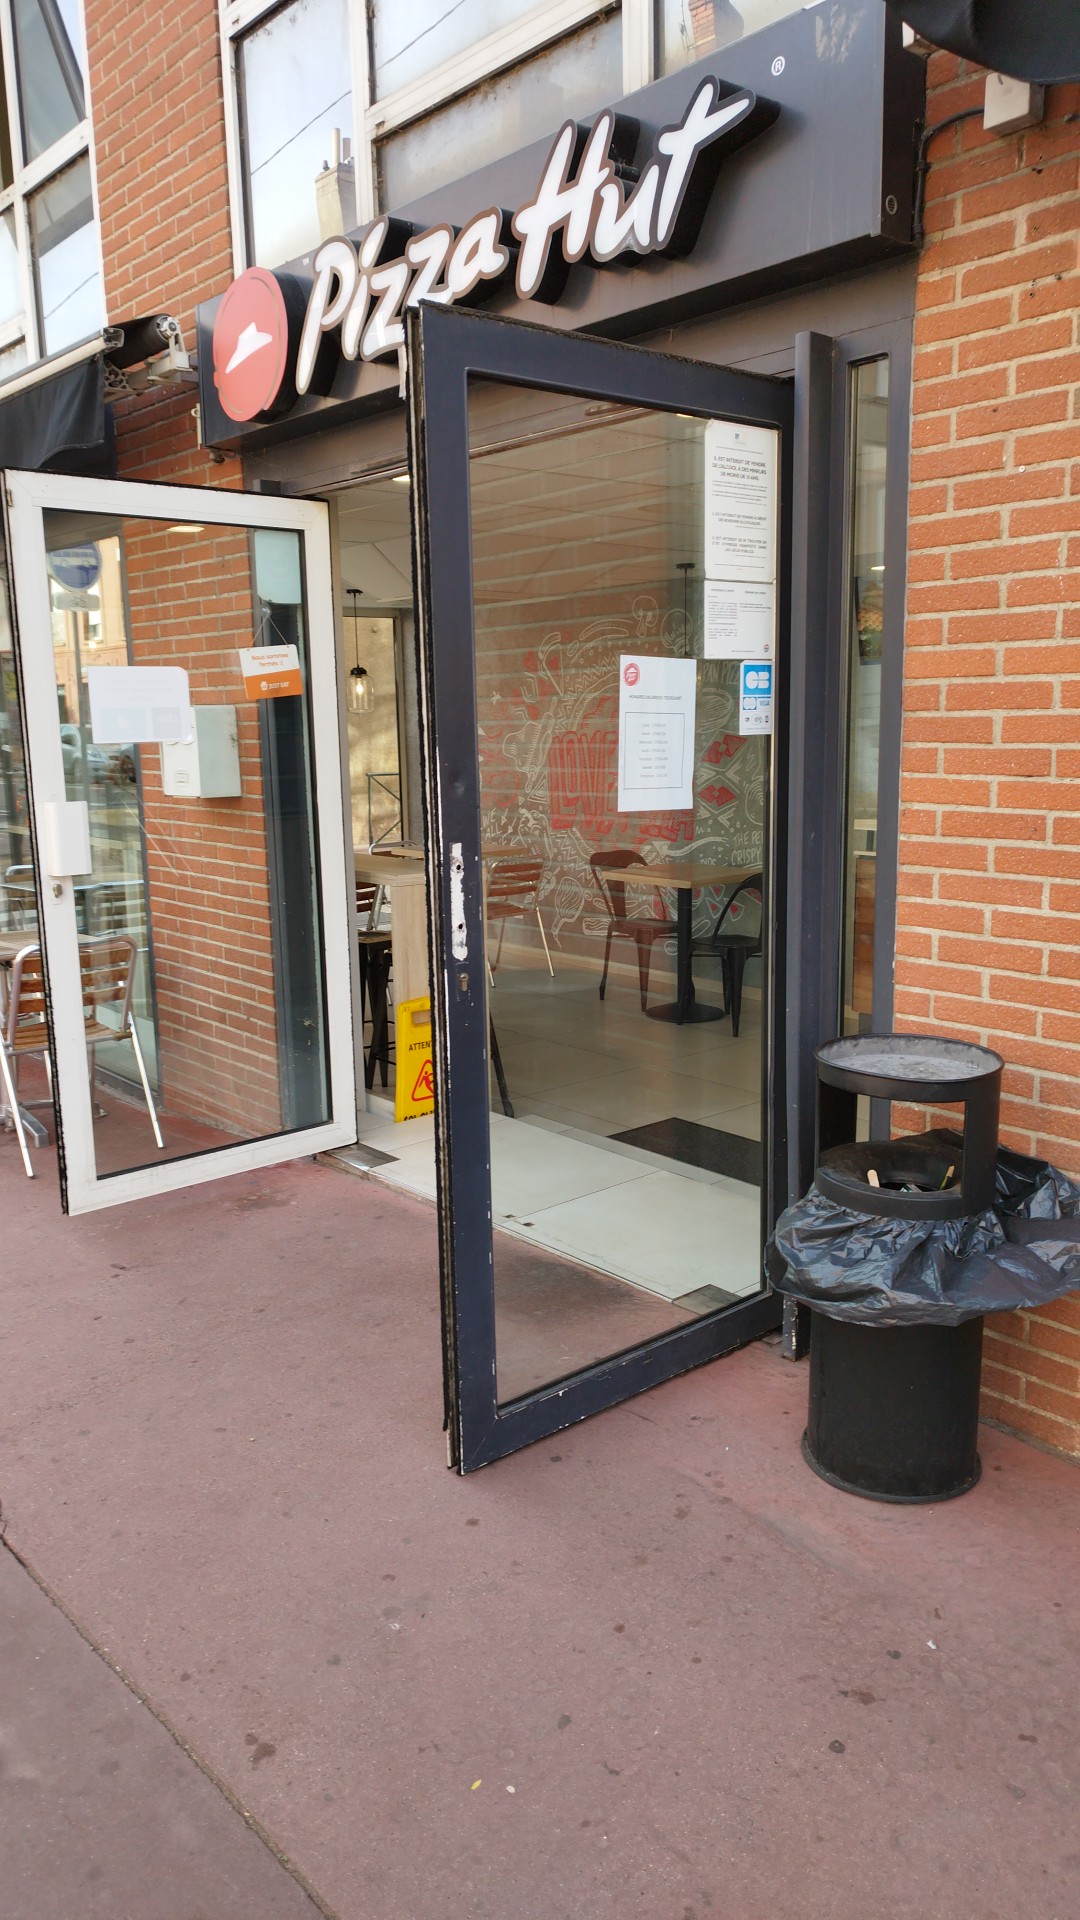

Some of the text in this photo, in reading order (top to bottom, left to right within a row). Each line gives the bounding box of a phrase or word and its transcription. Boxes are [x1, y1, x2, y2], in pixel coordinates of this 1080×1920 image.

[297, 78, 753, 394] Pizza Hut
[733, 831, 750, 847] THE
[731, 847, 762, 866] CRISPY
[408, 1040, 431, 1052] ATTEN
